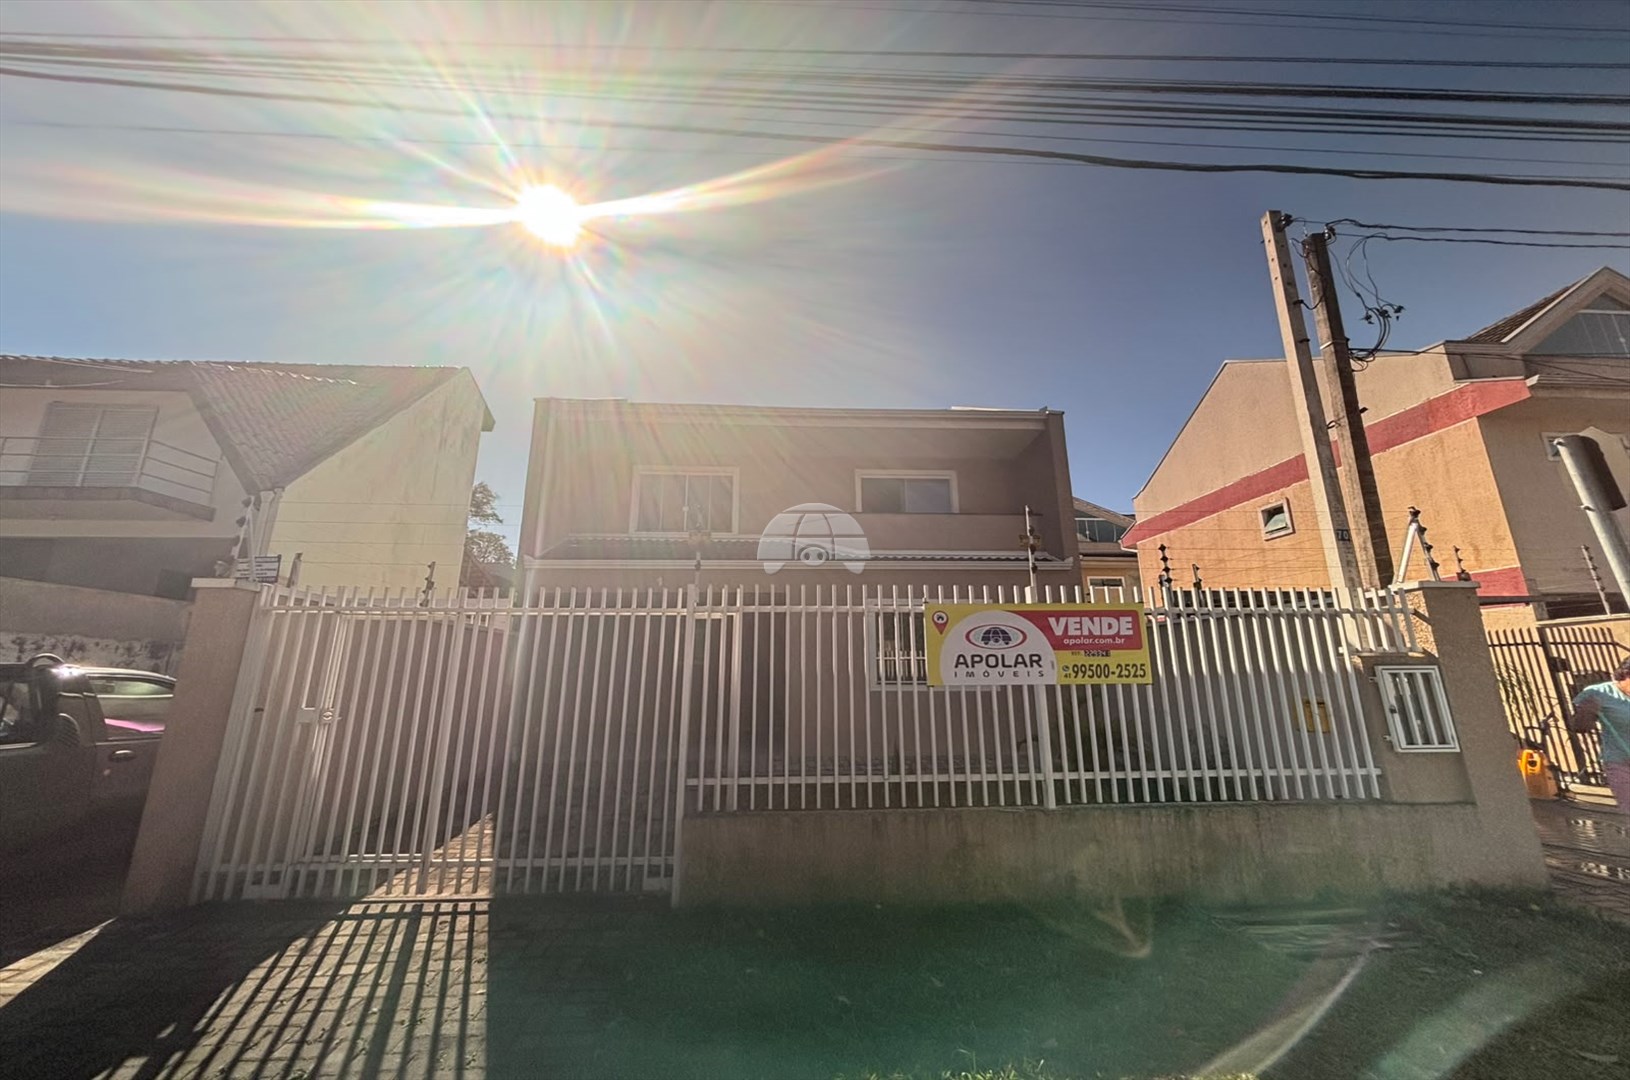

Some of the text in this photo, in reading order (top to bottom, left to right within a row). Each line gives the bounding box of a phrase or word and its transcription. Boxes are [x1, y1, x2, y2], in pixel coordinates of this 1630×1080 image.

[1048, 616, 1133, 636] VENDE
[1063, 637, 1125, 646] apolar.com.br
[954, 653, 1042, 668] APOLAR
[954, 670, 1044, 678] IMÓVEIS
[1072, 663, 1146, 679] 99500-2525
